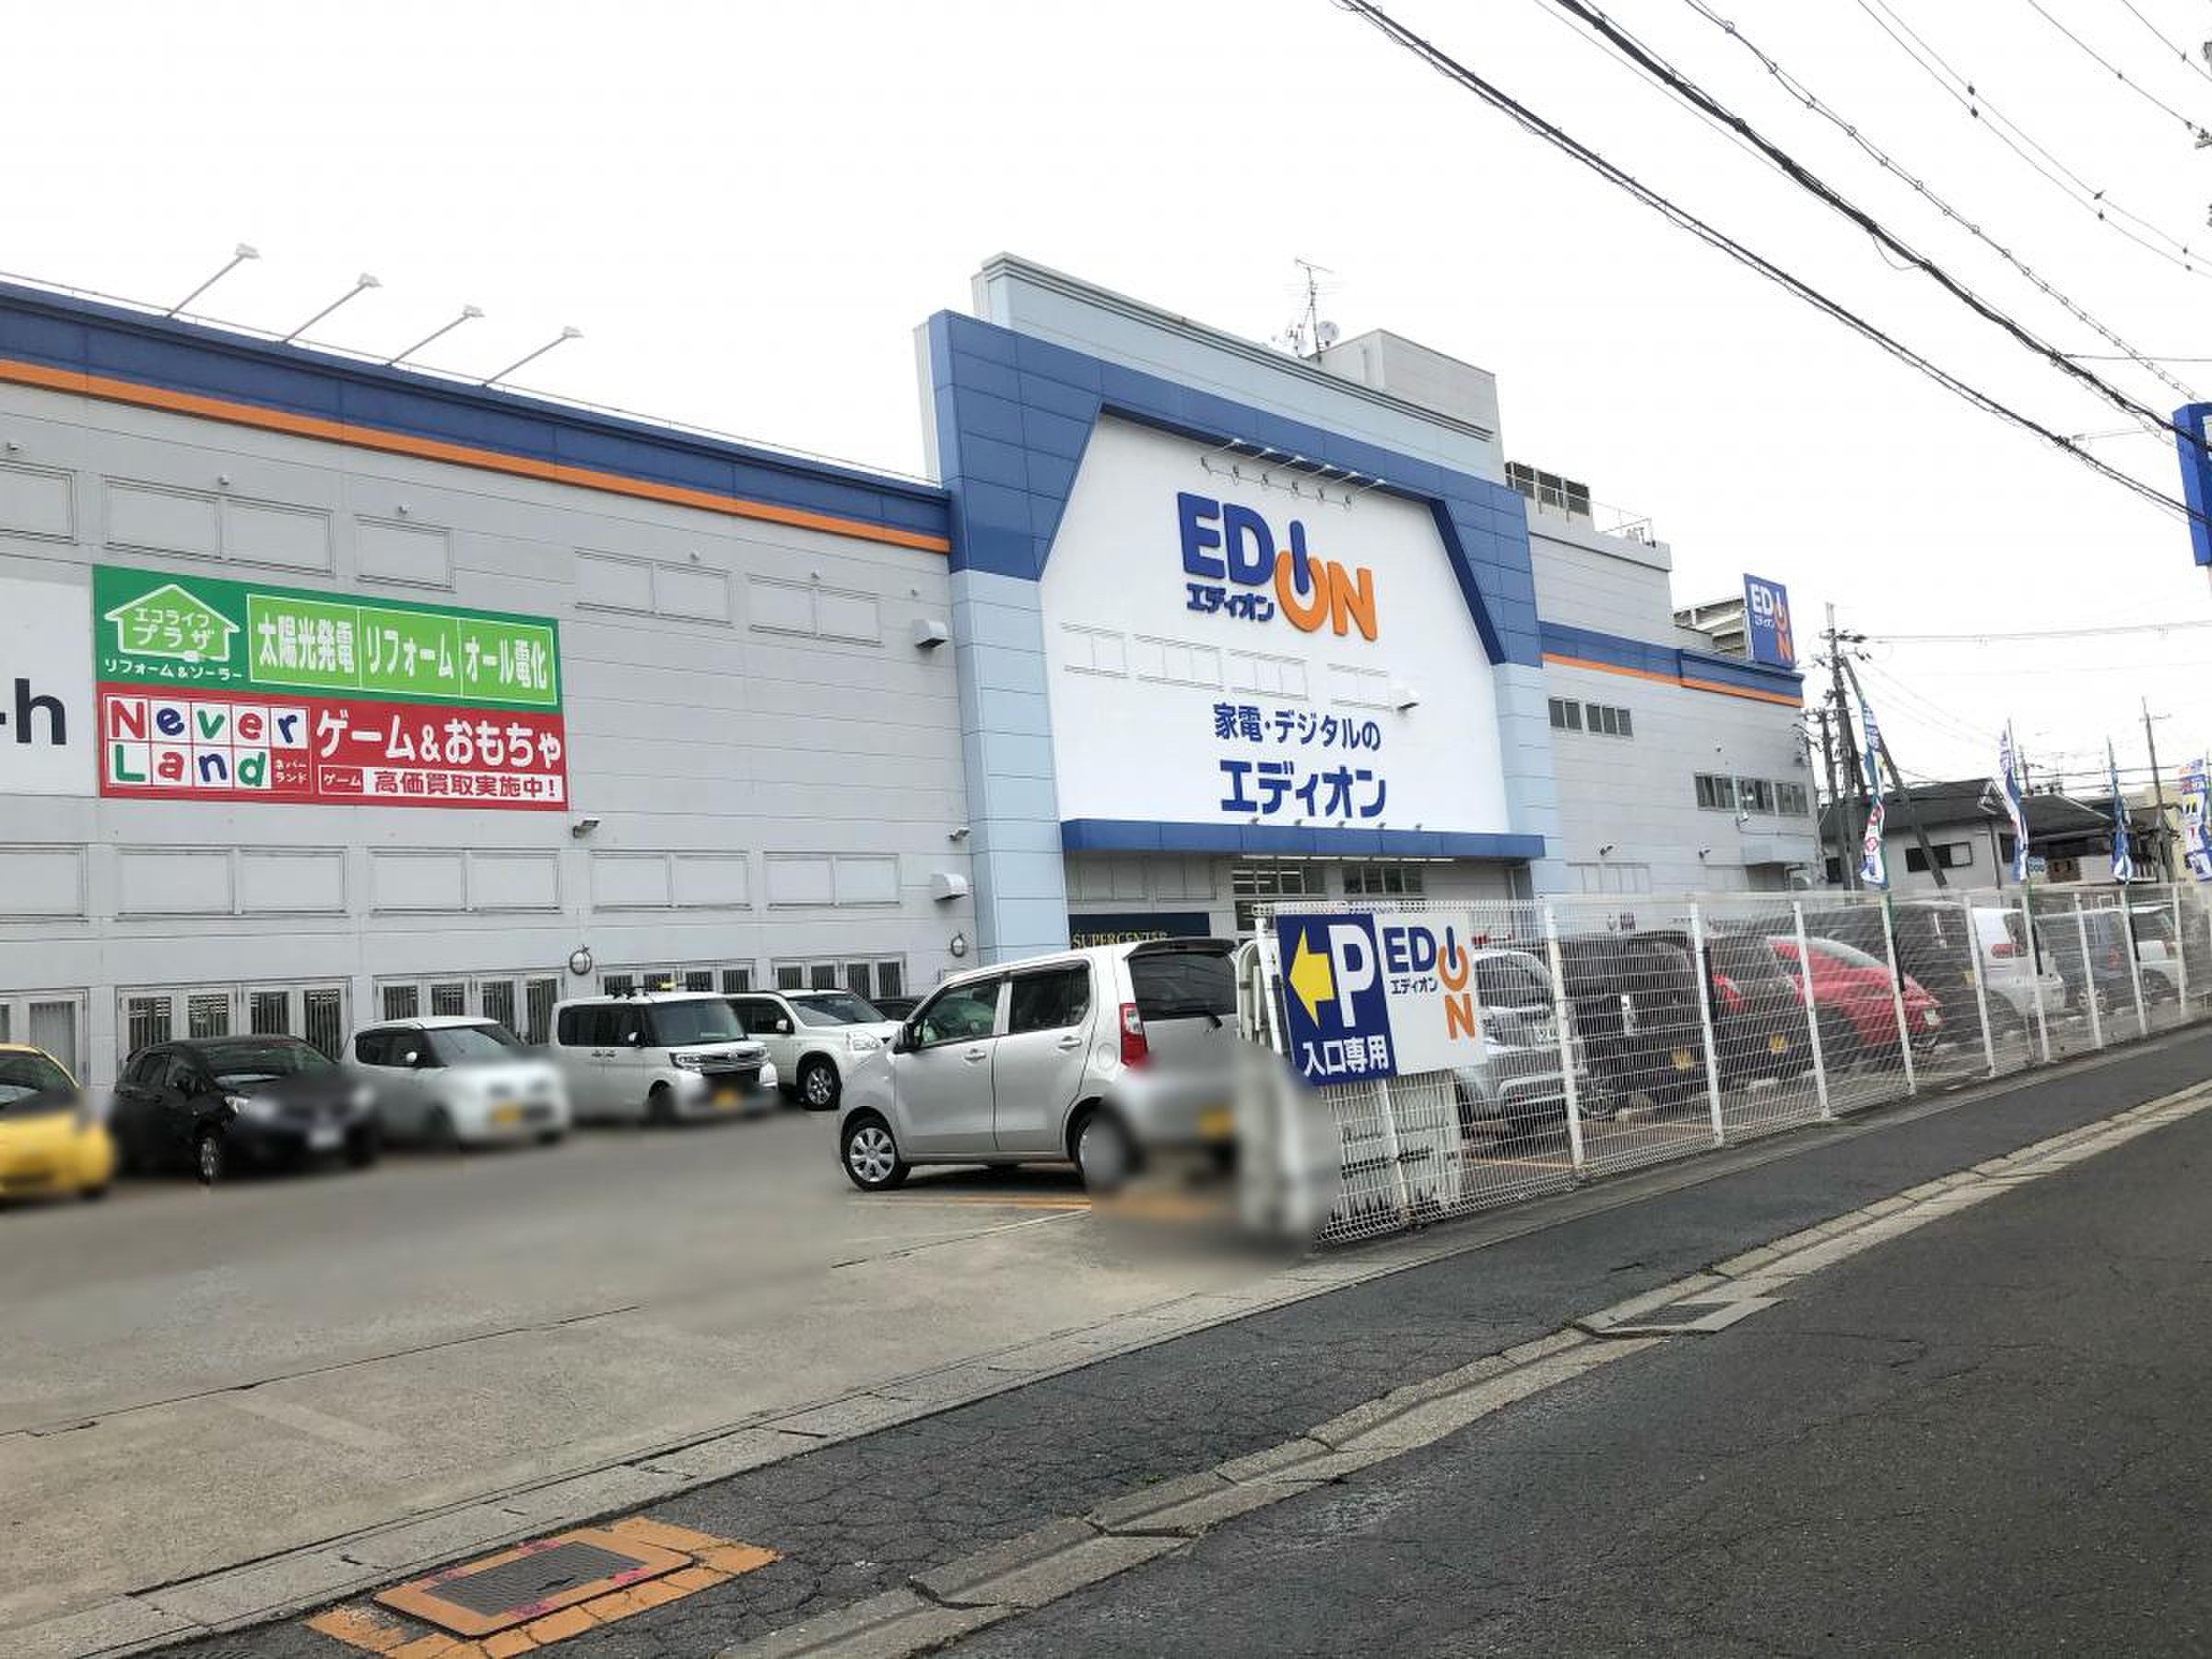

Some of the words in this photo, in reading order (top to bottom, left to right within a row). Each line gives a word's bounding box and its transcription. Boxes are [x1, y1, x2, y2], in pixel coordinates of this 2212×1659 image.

[1178, 491, 1377, 641] EDION
[134, 606, 211, 627] エコライフ
[1186, 582, 1275, 621] エディオン
[132, 624, 216, 651] プラザ
[257, 611, 355, 674] 太陽光発電
[368, 625, 454, 679] リフォーム
[465, 636, 548, 689] オール電化
[110, 700, 299, 745] Never
[113, 743, 267, 787] Land
[324, 772, 362, 788] ゲーム
[1219, 759, 1387, 819] エディオン
[1327, 924, 1375, 1028] P
[1382, 925, 1477, 1041] EDION
[1390, 976, 1439, 995] エディオン
[1302, 1034, 1390, 1077] 入口専用
